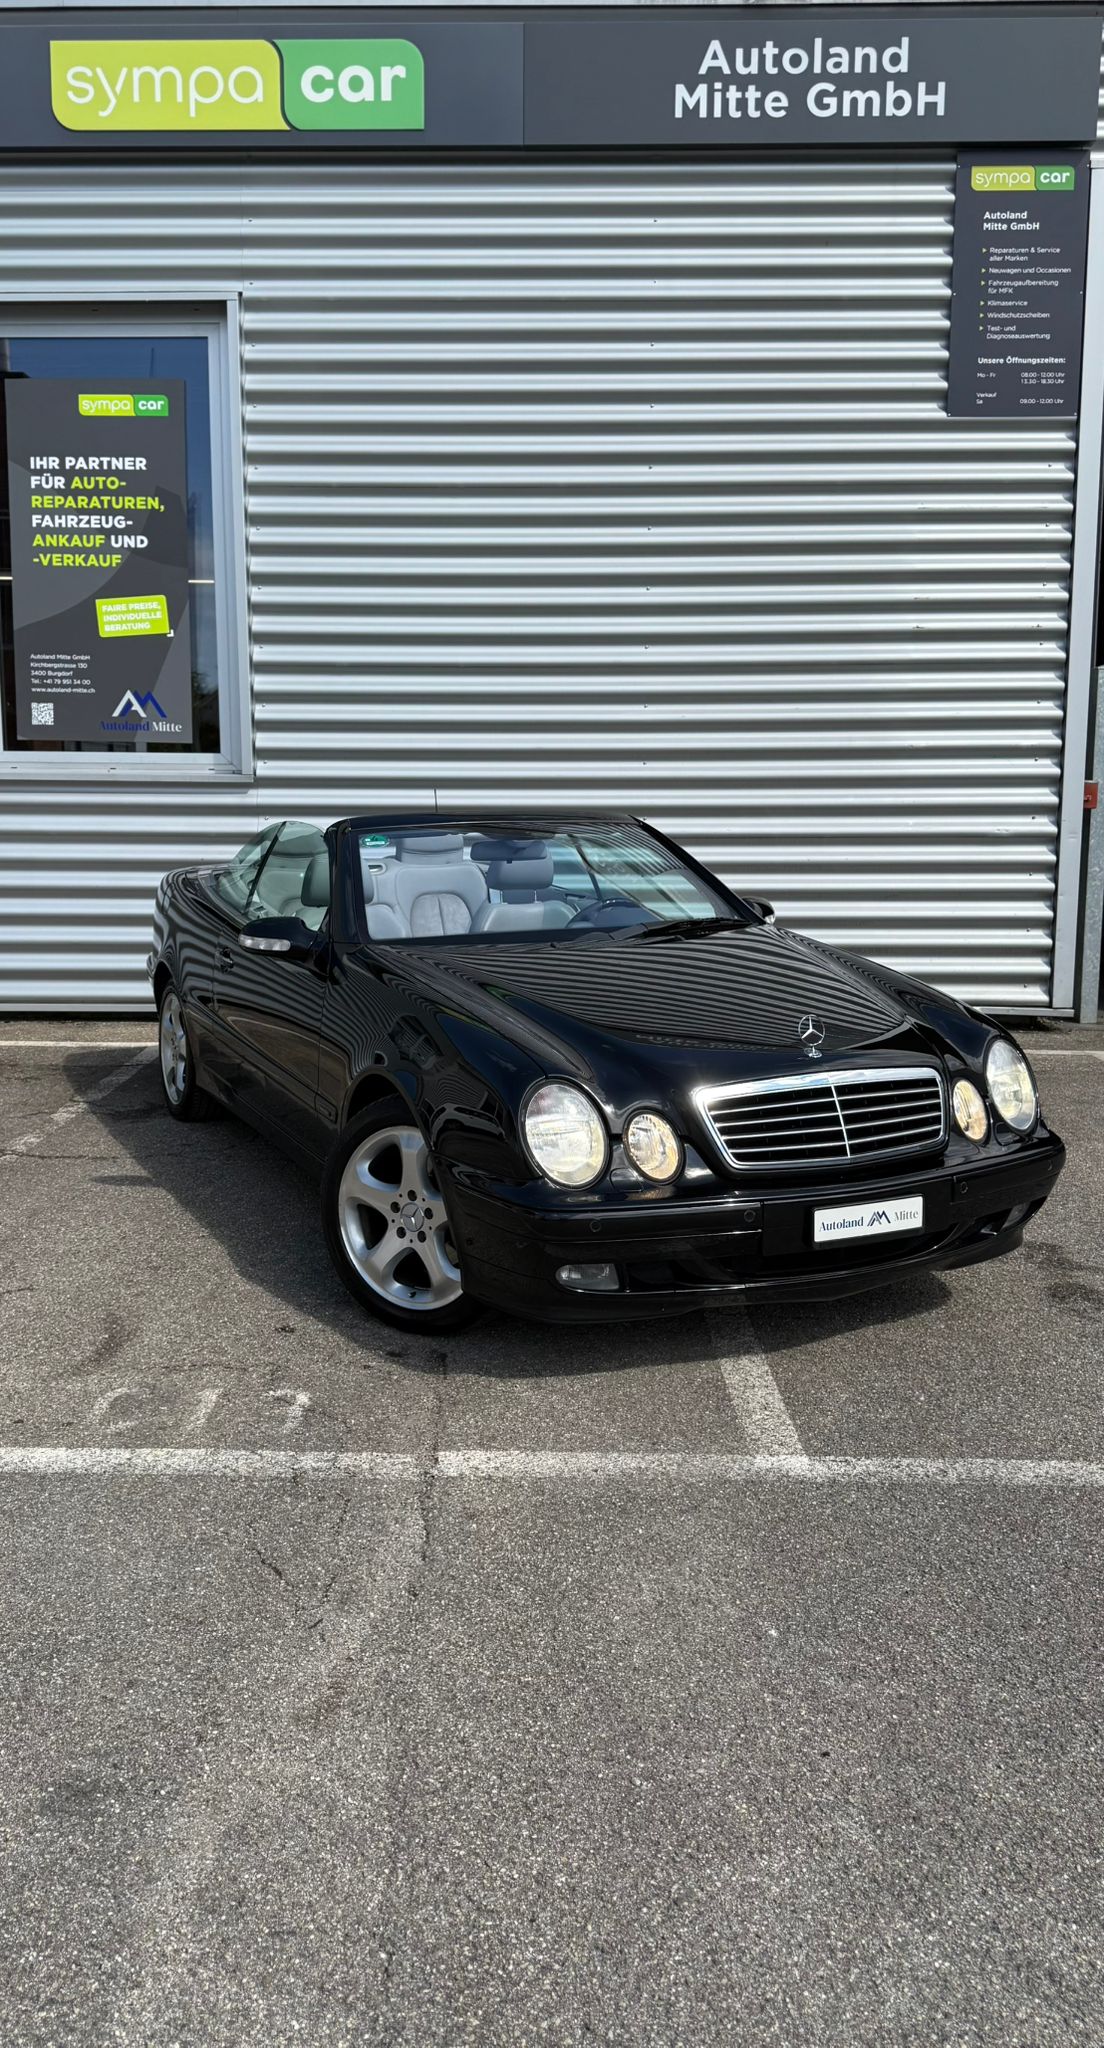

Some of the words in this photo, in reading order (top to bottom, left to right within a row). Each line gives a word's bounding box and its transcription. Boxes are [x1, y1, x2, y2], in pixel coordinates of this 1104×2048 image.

[698, 36, 910, 75] Autoland
[65, 65, 264, 117] sympa
[300, 65, 407, 103] car
[674, 82, 789, 119] Mitte
[806, 81, 946, 117] GmbH
[975, 172, 1031, 187] sympa
[1040, 172, 1070, 183] car
[983, 211, 1027, 220] Autoland
[983, 222, 1008, 231] Mitte
[1010, 222, 1040, 230] GmbH
[1006, 356, 1066, 365] Öffnungszeiten:
[82, 399, 131, 413] sympa
[138, 399, 164, 410] car
[30, 456, 60, 470] IHR
[65, 456, 147, 471] PARTNER
[30, 473, 65, 489] FÜR
[70, 476, 127, 489] AUTO-
[31, 495, 165, 512] REPARATUREN,
[31, 515, 133, 529] FAHRZEUG-
[32, 534, 106, 547] ANKAUF
[110, 535, 149, 548] UND
[33, 554, 122, 567] -VERKAUF
[102, 604, 127, 613] FAIRE
[128, 602, 161, 611] PREISE,
[103, 611, 162, 622] INDIVIDUELLE
[104, 622, 151, 632] BERATUNG
[101, 721, 149, 731] Autoland
[152, 721, 182, 732] Mitte
[819, 1217, 864, 1232] Autoland
[894, 1210, 919, 1222] Mitte
